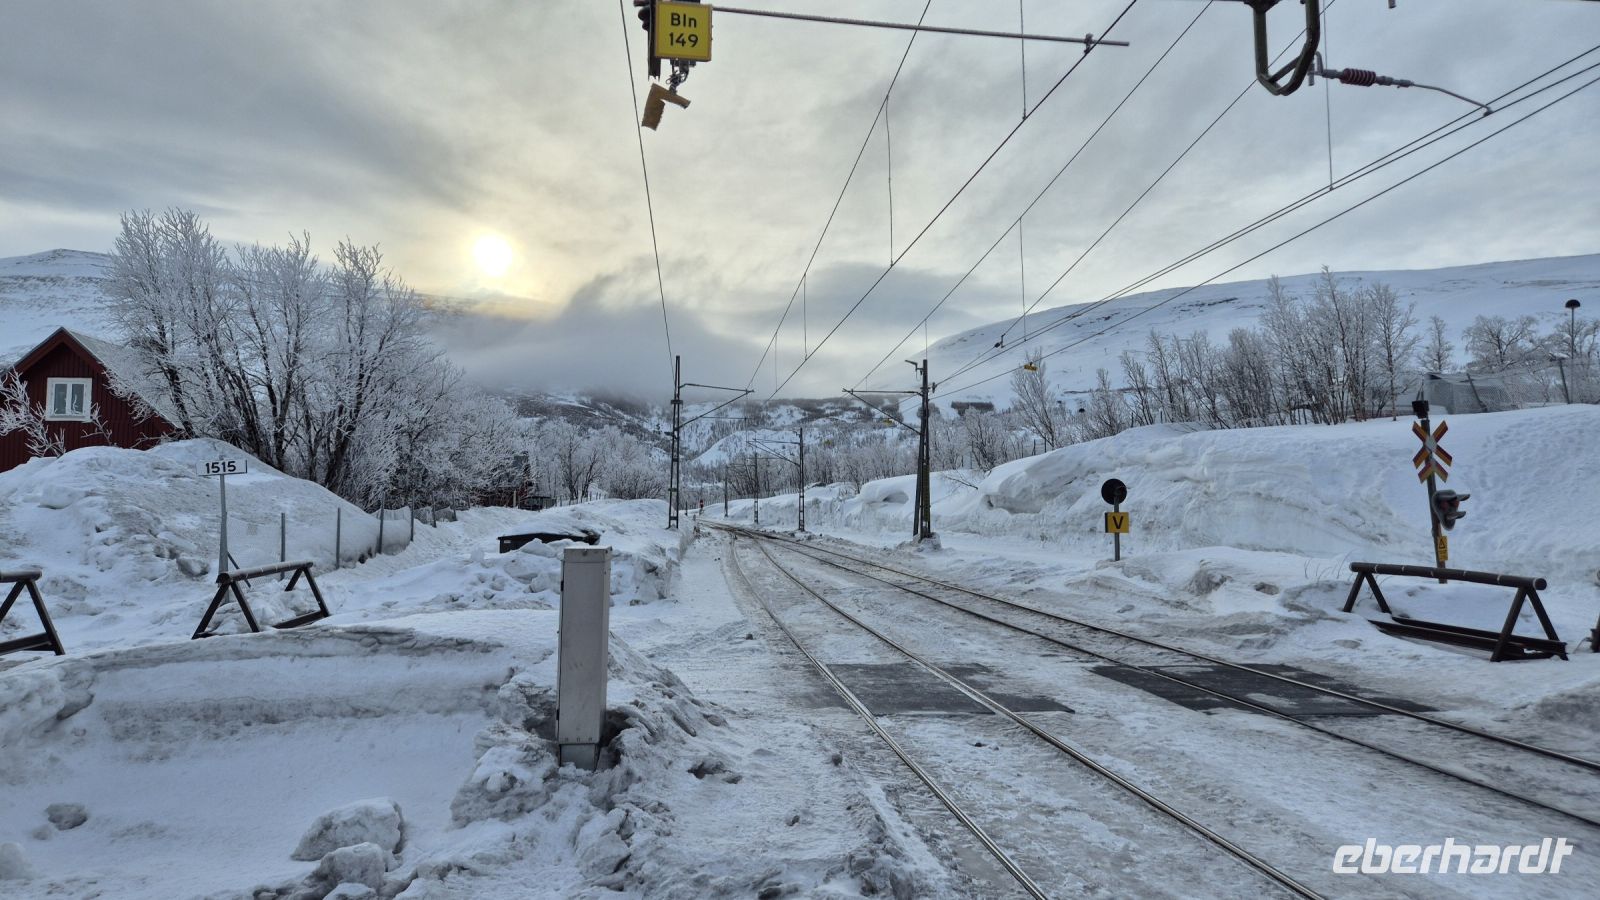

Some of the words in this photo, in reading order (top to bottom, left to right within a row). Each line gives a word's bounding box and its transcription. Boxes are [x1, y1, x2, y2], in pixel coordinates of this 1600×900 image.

[670, 12, 697, 28] Bln
[669, 32, 698, 47] 149
[205, 460, 236, 474] 1515
[1112, 515, 1124, 530] V
